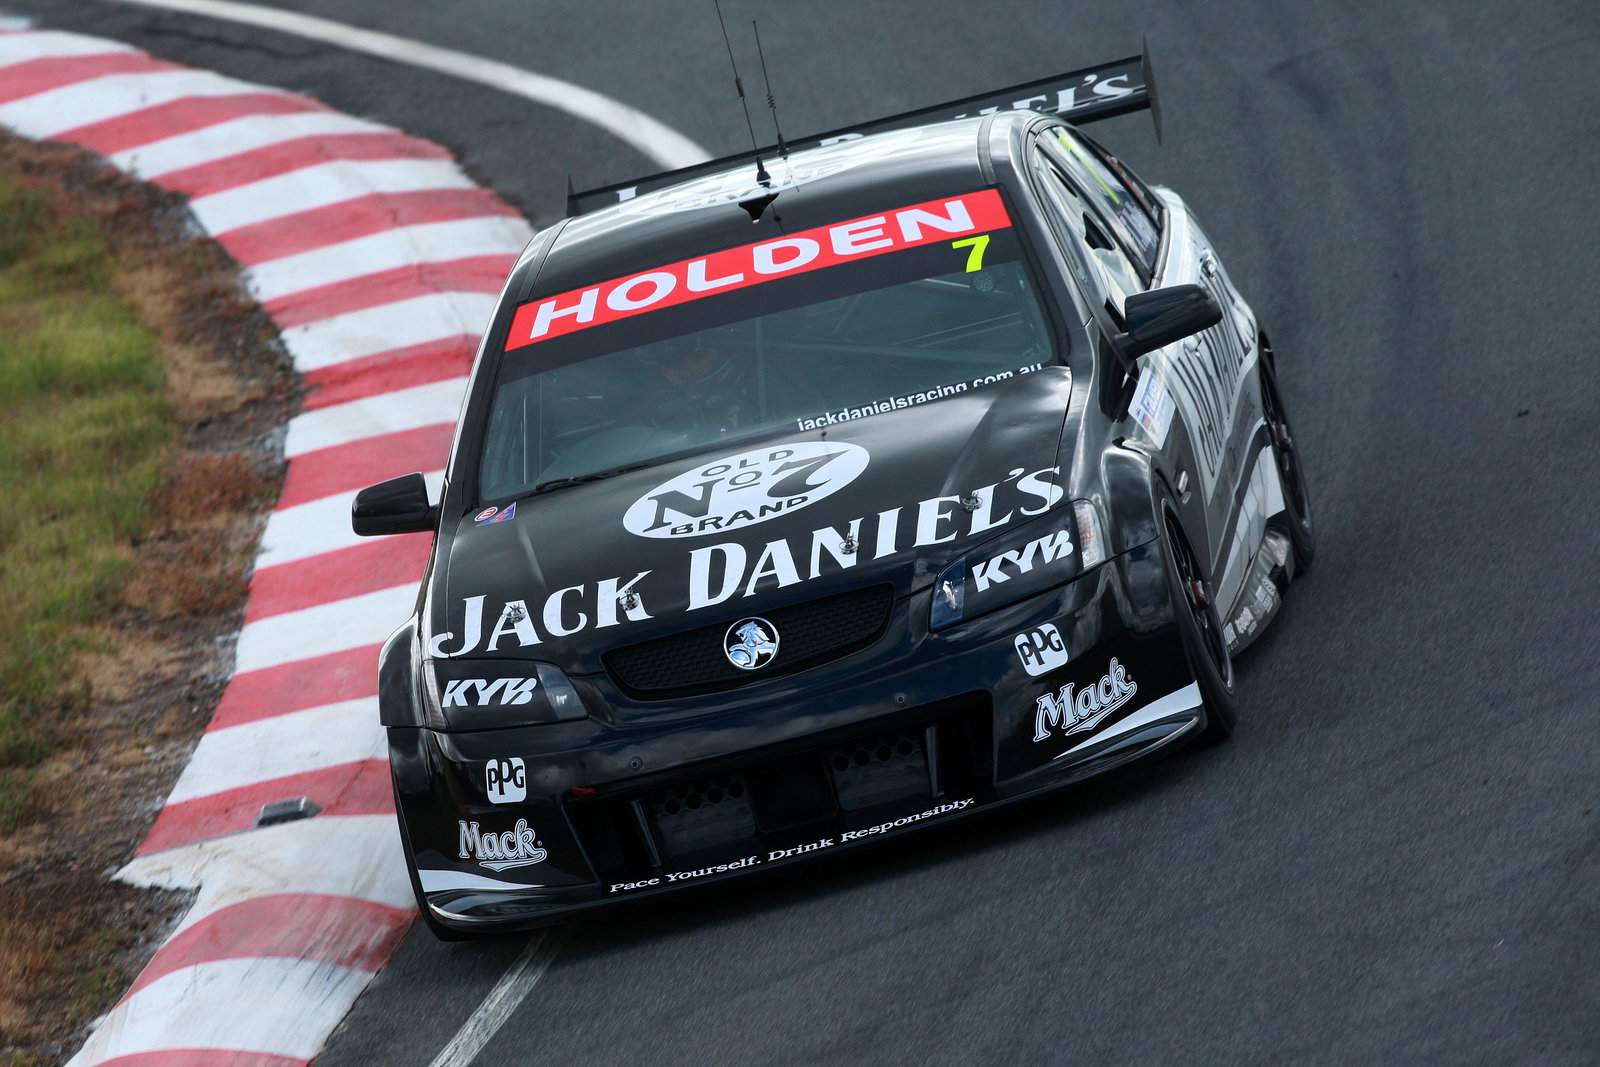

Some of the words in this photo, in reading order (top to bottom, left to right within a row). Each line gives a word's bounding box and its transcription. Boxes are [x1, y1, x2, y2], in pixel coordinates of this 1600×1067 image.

[529, 199, 975, 340] HOLDEN
[951, 234, 991, 273] 7
[701, 449, 795, 477] OLD
[767, 449, 851, 498] 7
[670, 495, 809, 536] BRAND
[426, 569, 655, 660] JACK
[685, 466, 1065, 612] DANIEL'S
[971, 529, 1074, 593] KYB
[1017, 626, 1064, 667] PPG
[441, 677, 538, 708] KYB
[1033, 656, 1138, 742] Mack
[487, 758, 526, 796] PPG
[458, 818, 548, 872] Mack
[609, 877, 660, 893] Pace
[665, 854, 762, 882] Yourself.
[767, 838, 835, 862] Drink
[840, 797, 975, 844] Responsibly.
